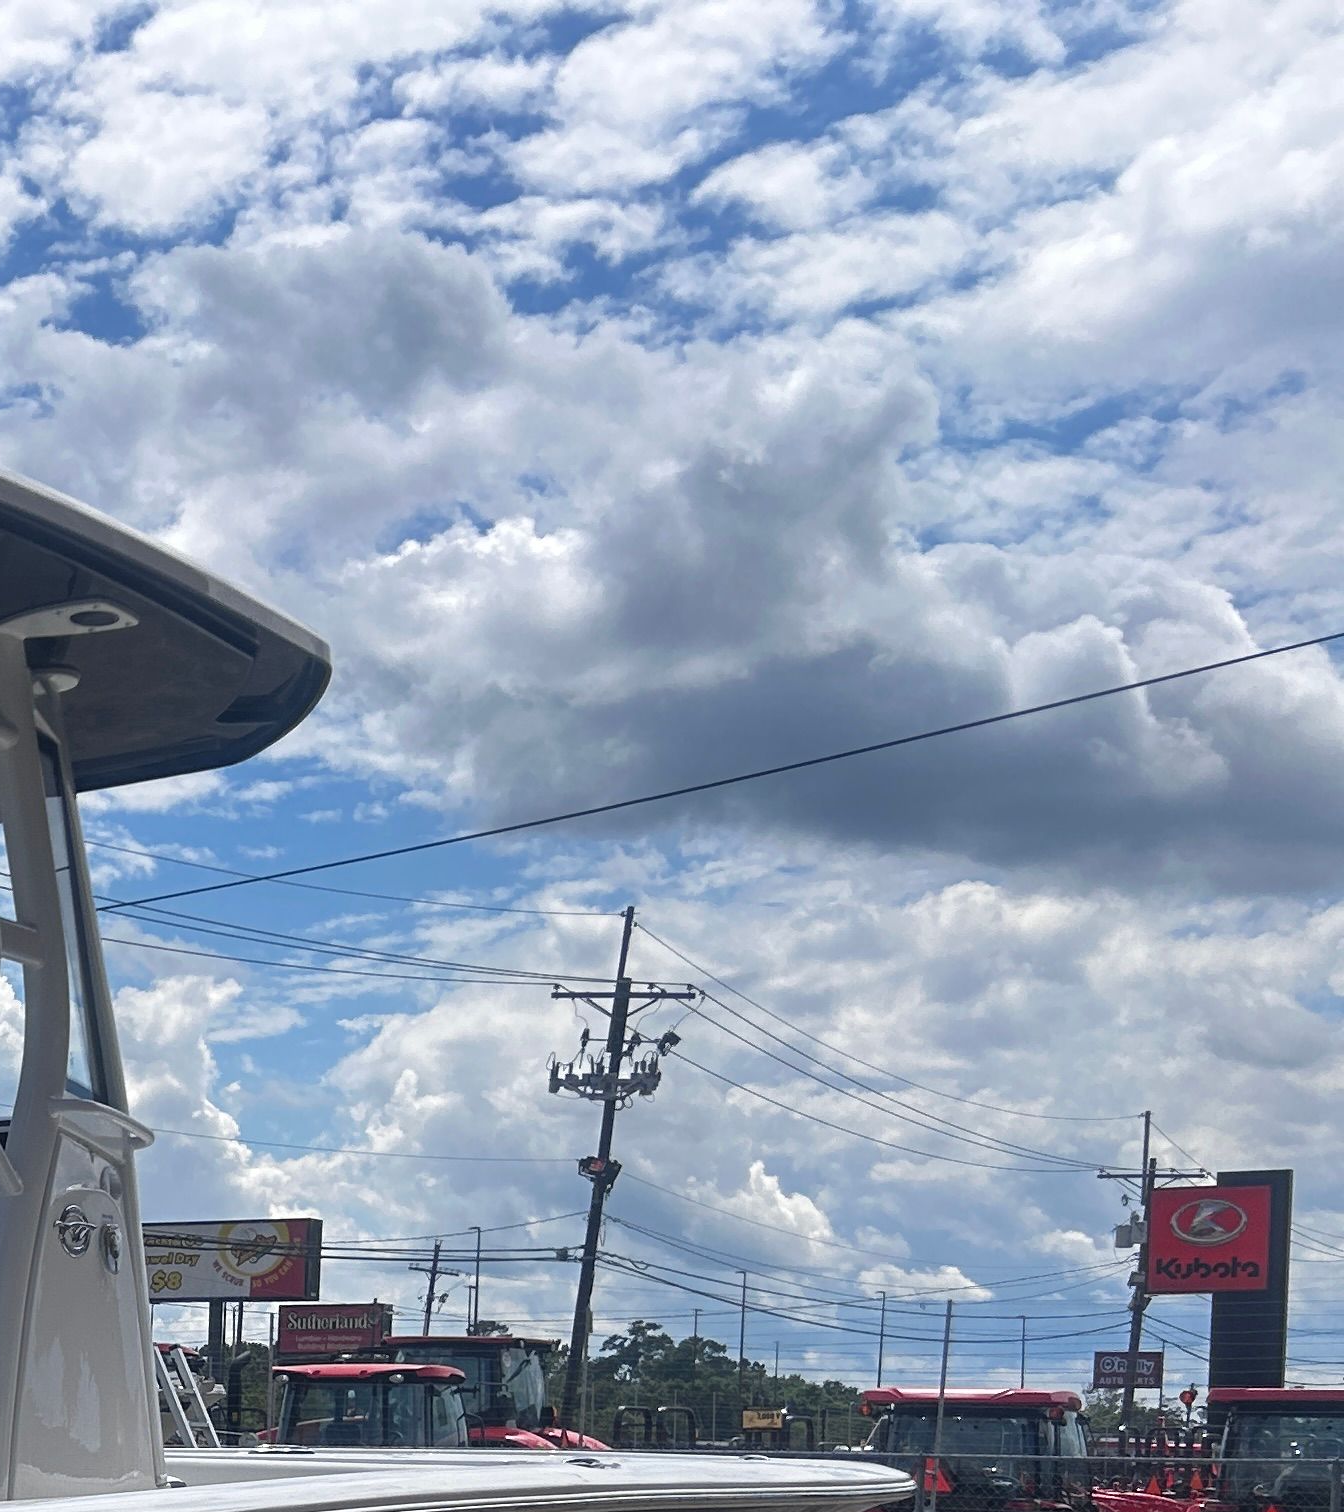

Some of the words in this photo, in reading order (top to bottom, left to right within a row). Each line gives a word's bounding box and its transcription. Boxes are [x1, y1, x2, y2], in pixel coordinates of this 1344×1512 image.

[175, 1252, 200, 1267] Dry
[1155, 1256, 1260, 1280] Kubota
[150, 1269, 183, 1293] $8
[1099, 1377, 1124, 1385] AUTO
